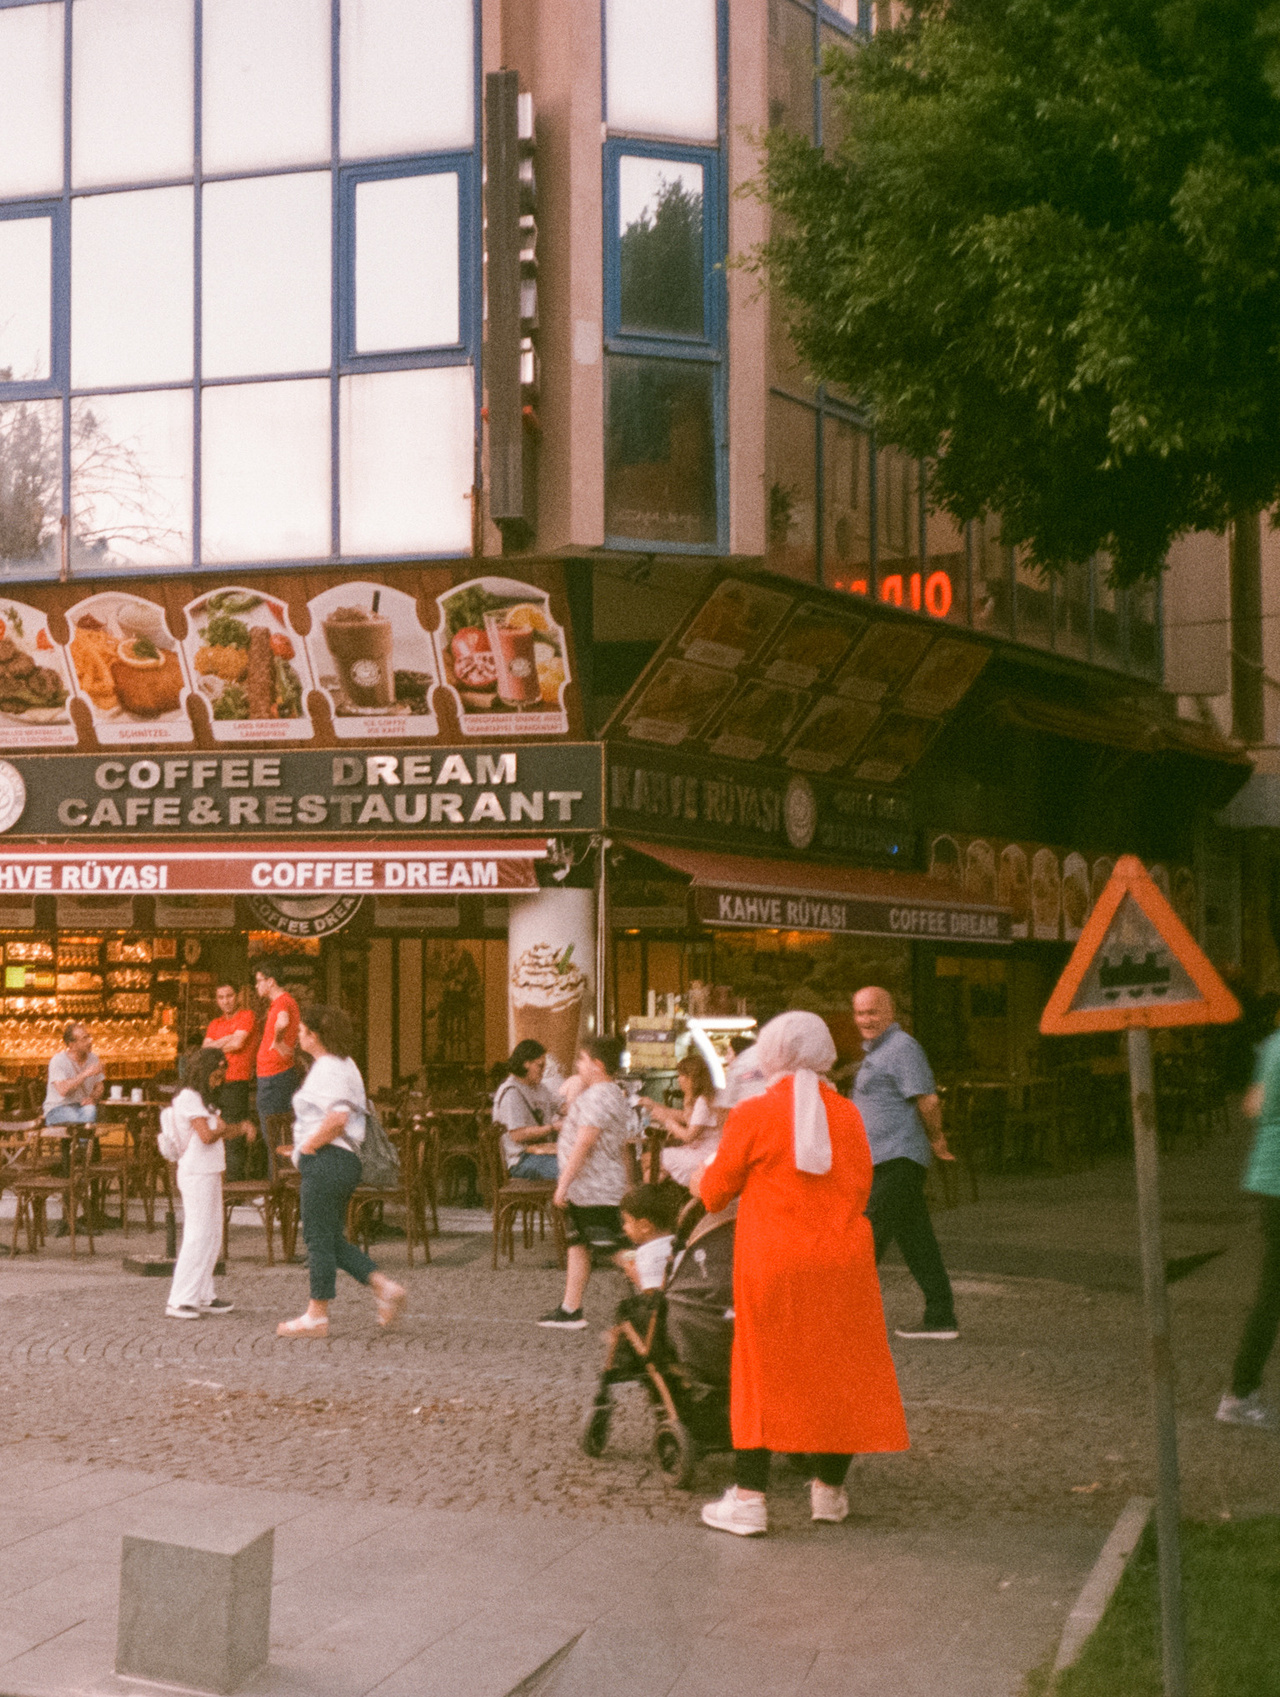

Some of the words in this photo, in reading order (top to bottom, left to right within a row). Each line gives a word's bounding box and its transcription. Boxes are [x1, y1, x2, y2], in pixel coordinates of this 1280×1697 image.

[94, 758, 282, 791] COFFEE
[332, 752, 518, 788] DREAM
[61, 861, 168, 889] RÜYASI
[251, 862, 375, 887] COFFEE
[384, 861, 499, 887] DREAM
[313, 897, 356, 933] DREA
[719, 894, 782, 924] KAHVE
[786, 898, 847, 928] RÜYASI
[888, 907, 947, 933] COFFEE
[950, 912, 999, 936] DREAM
